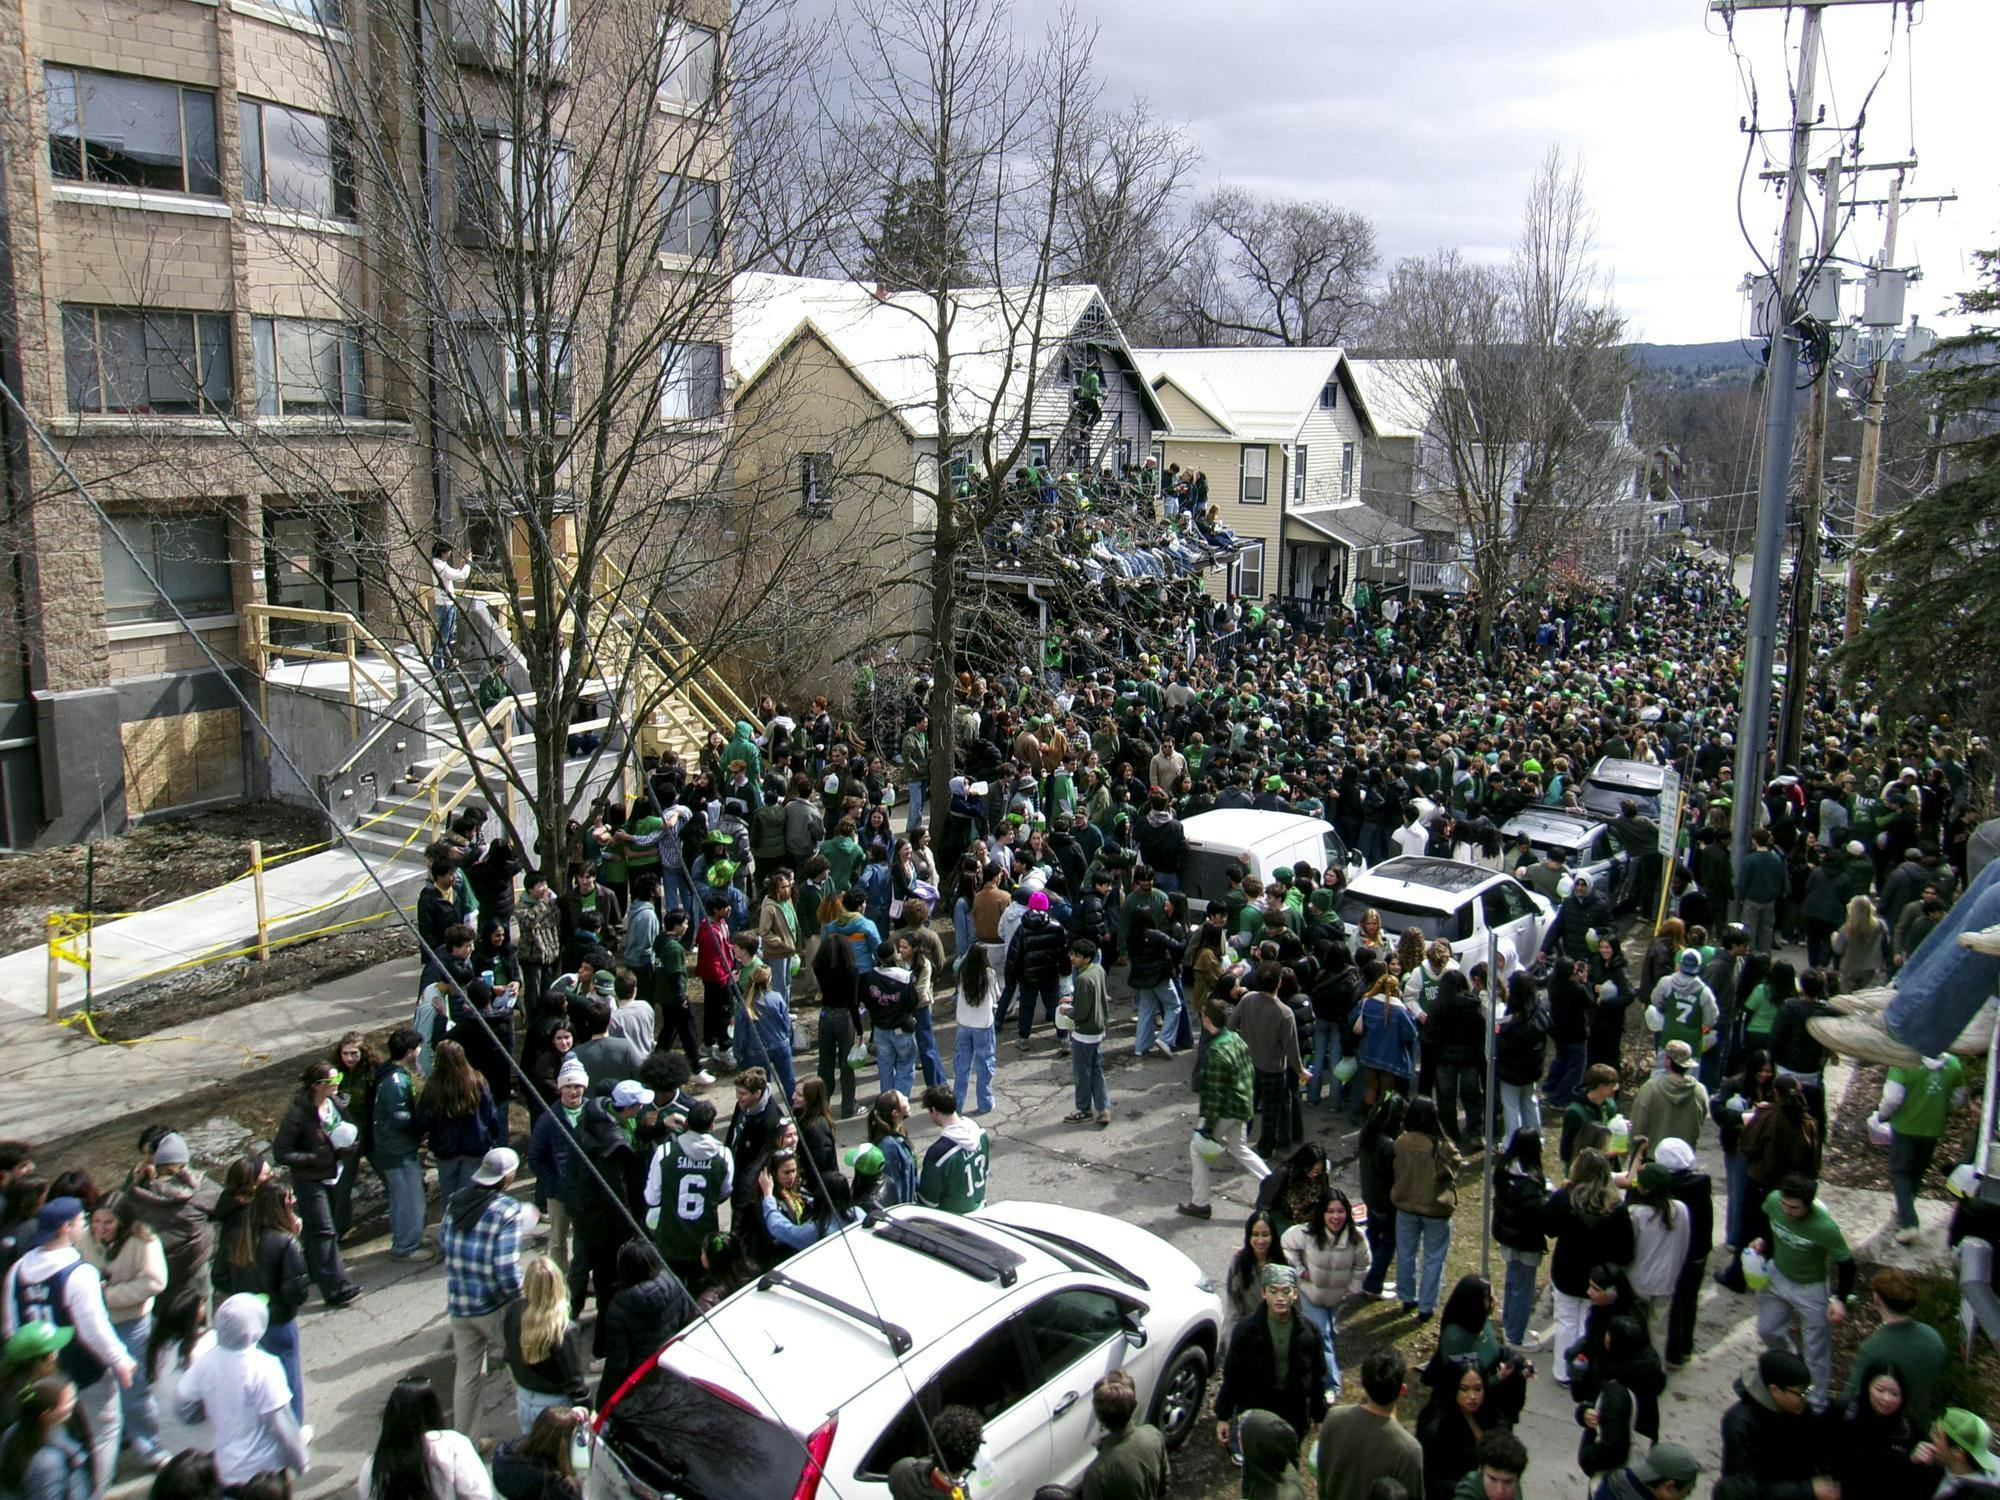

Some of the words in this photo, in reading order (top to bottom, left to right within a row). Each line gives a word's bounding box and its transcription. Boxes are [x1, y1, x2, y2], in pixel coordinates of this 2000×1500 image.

[1675, 1001, 1693, 1024] 7
[677, 1173, 707, 1220] 6
[964, 1153, 986, 1197] 13
